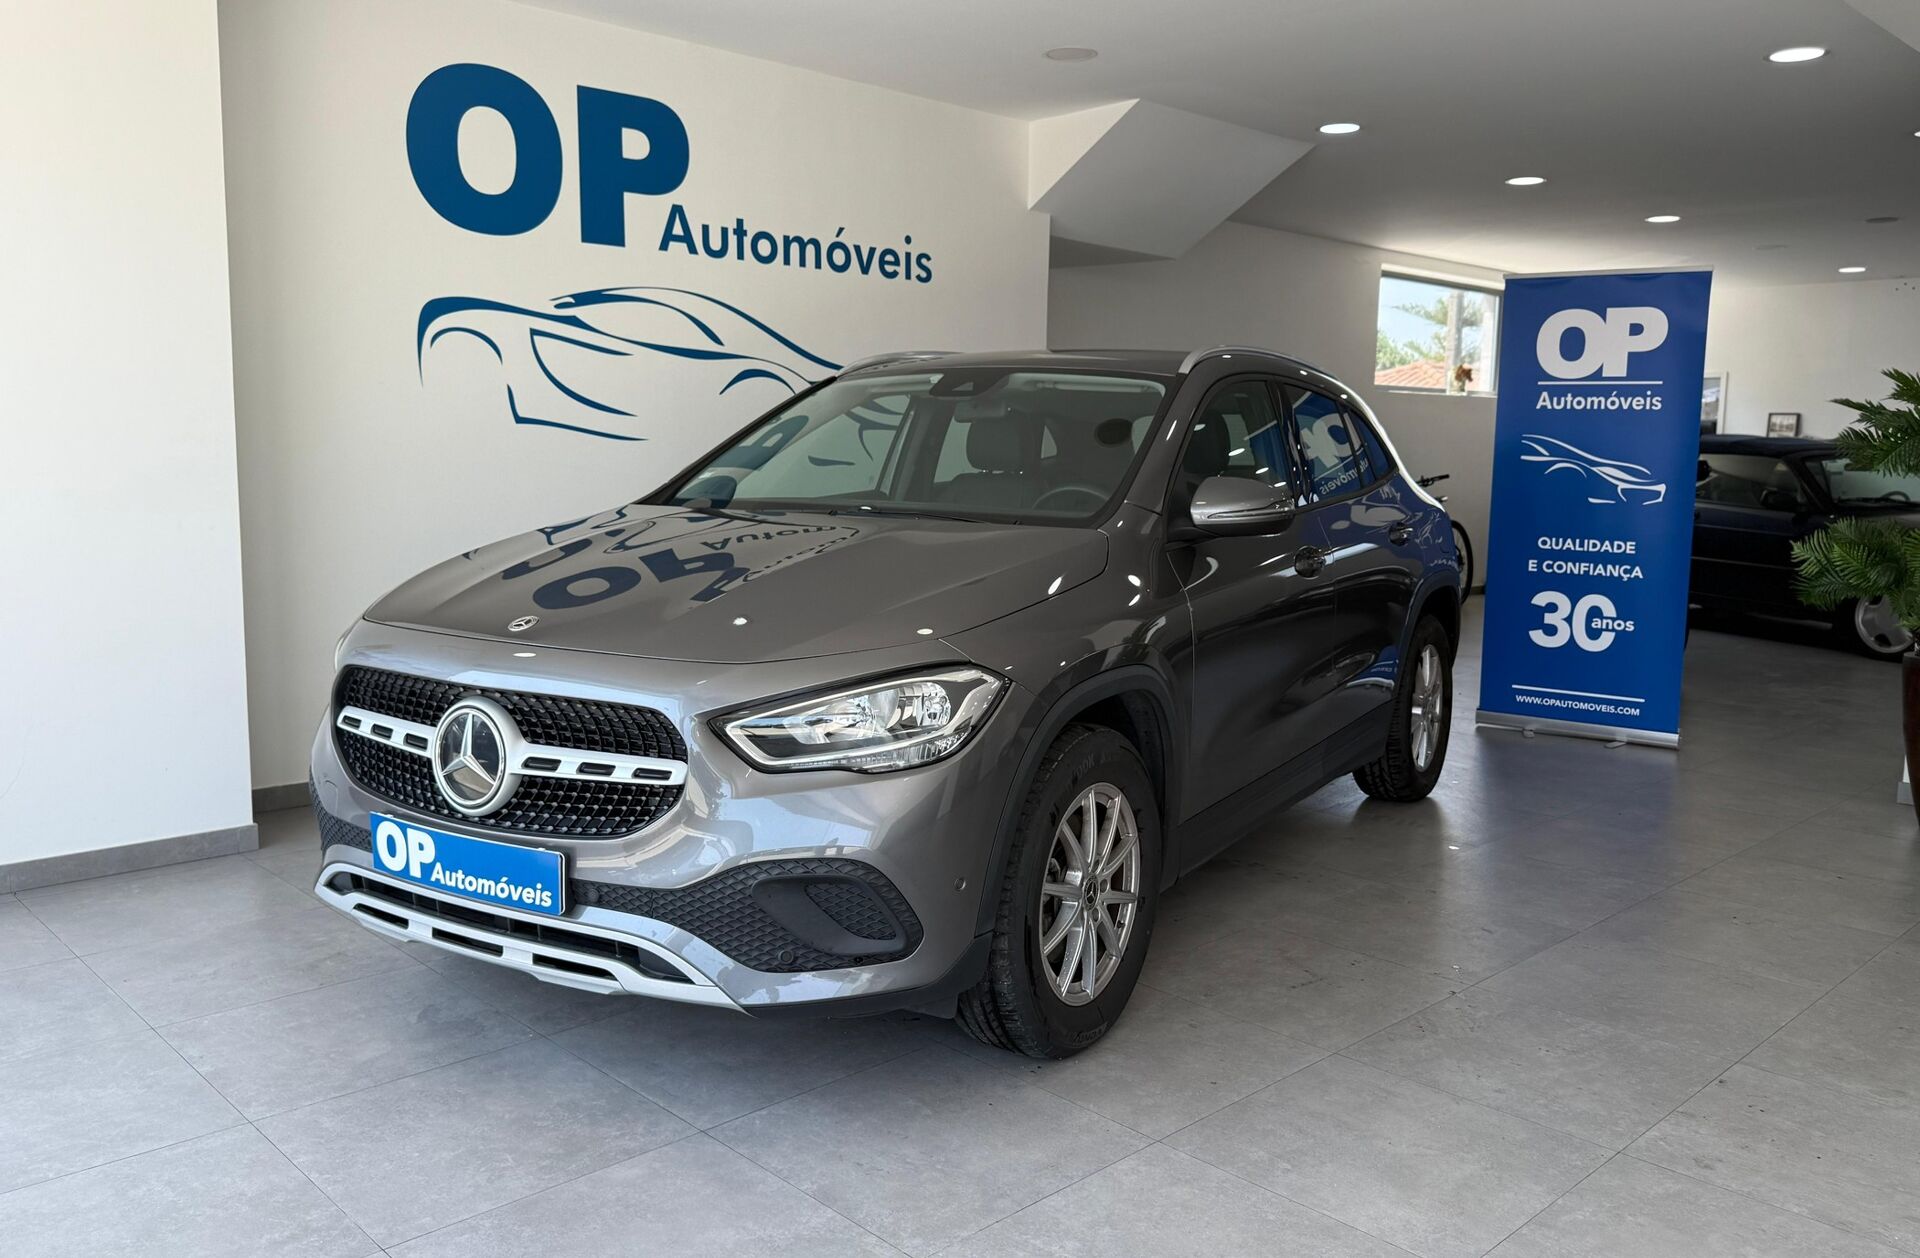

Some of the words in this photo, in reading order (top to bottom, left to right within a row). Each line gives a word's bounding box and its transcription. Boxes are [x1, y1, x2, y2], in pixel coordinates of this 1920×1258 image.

[406, 63, 690, 247] OP
[660, 205, 932, 283] Automóveis
[1536, 306, 1669, 381] OP
[1535, 390, 1663, 411] Automóveis
[1537, 536, 1636, 554] QUALIDADE
[1528, 559, 1538, 572] E
[1542, 560, 1643, 581] CONFIANÇA
[1528, 590, 1618, 652] 30
[1591, 617, 1635, 632] anos
[1515, 694, 1640, 716] WWW.OPAUTOMOVEIS.COM
[376, 820, 436, 879] OP
[431, 862, 552, 908] Automóveis
